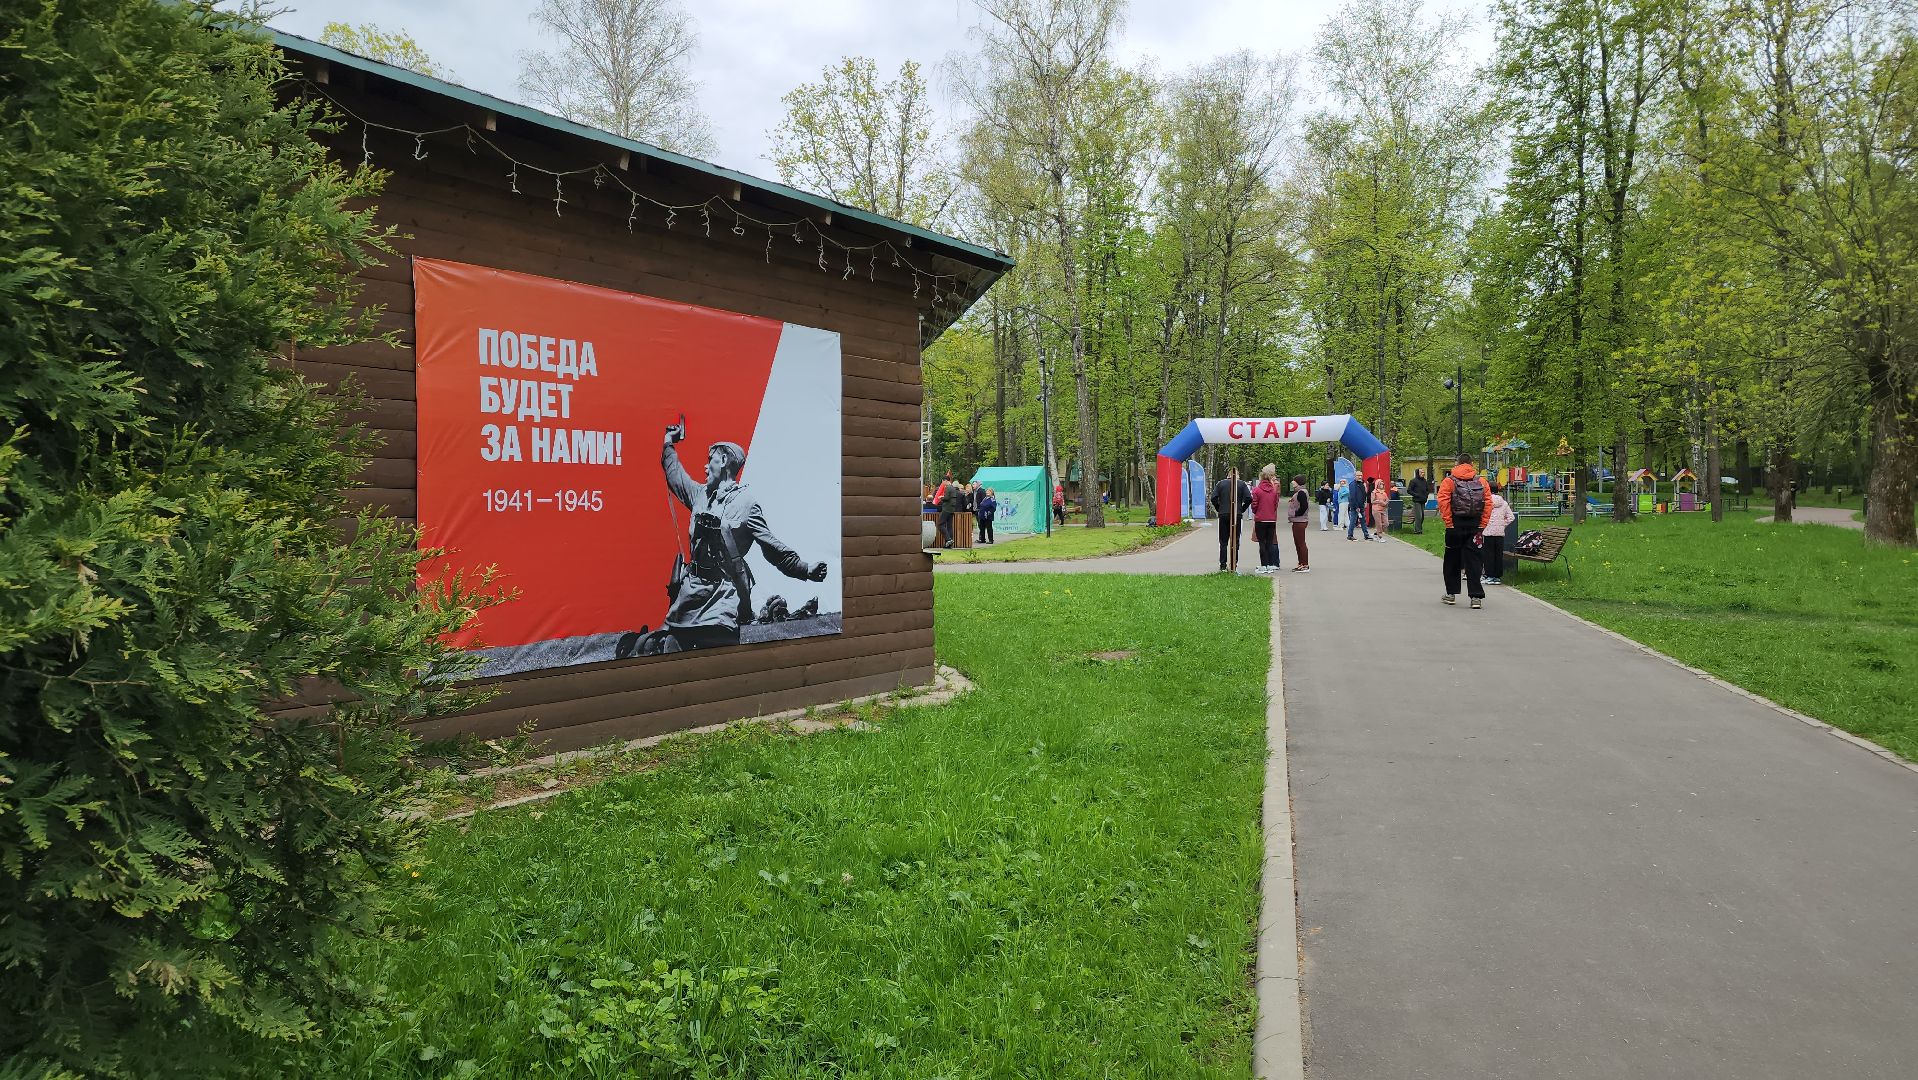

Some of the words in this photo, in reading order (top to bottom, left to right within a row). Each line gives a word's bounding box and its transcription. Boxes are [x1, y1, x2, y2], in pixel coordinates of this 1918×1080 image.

[478, 328, 598, 380] ПОБЕДА
[479, 375, 574, 422] БУДЕТ
[480, 424, 522, 462] ЗА
[531, 427, 622, 465] НАМИ!
[1228, 419, 1316, 439] СТАРТ
